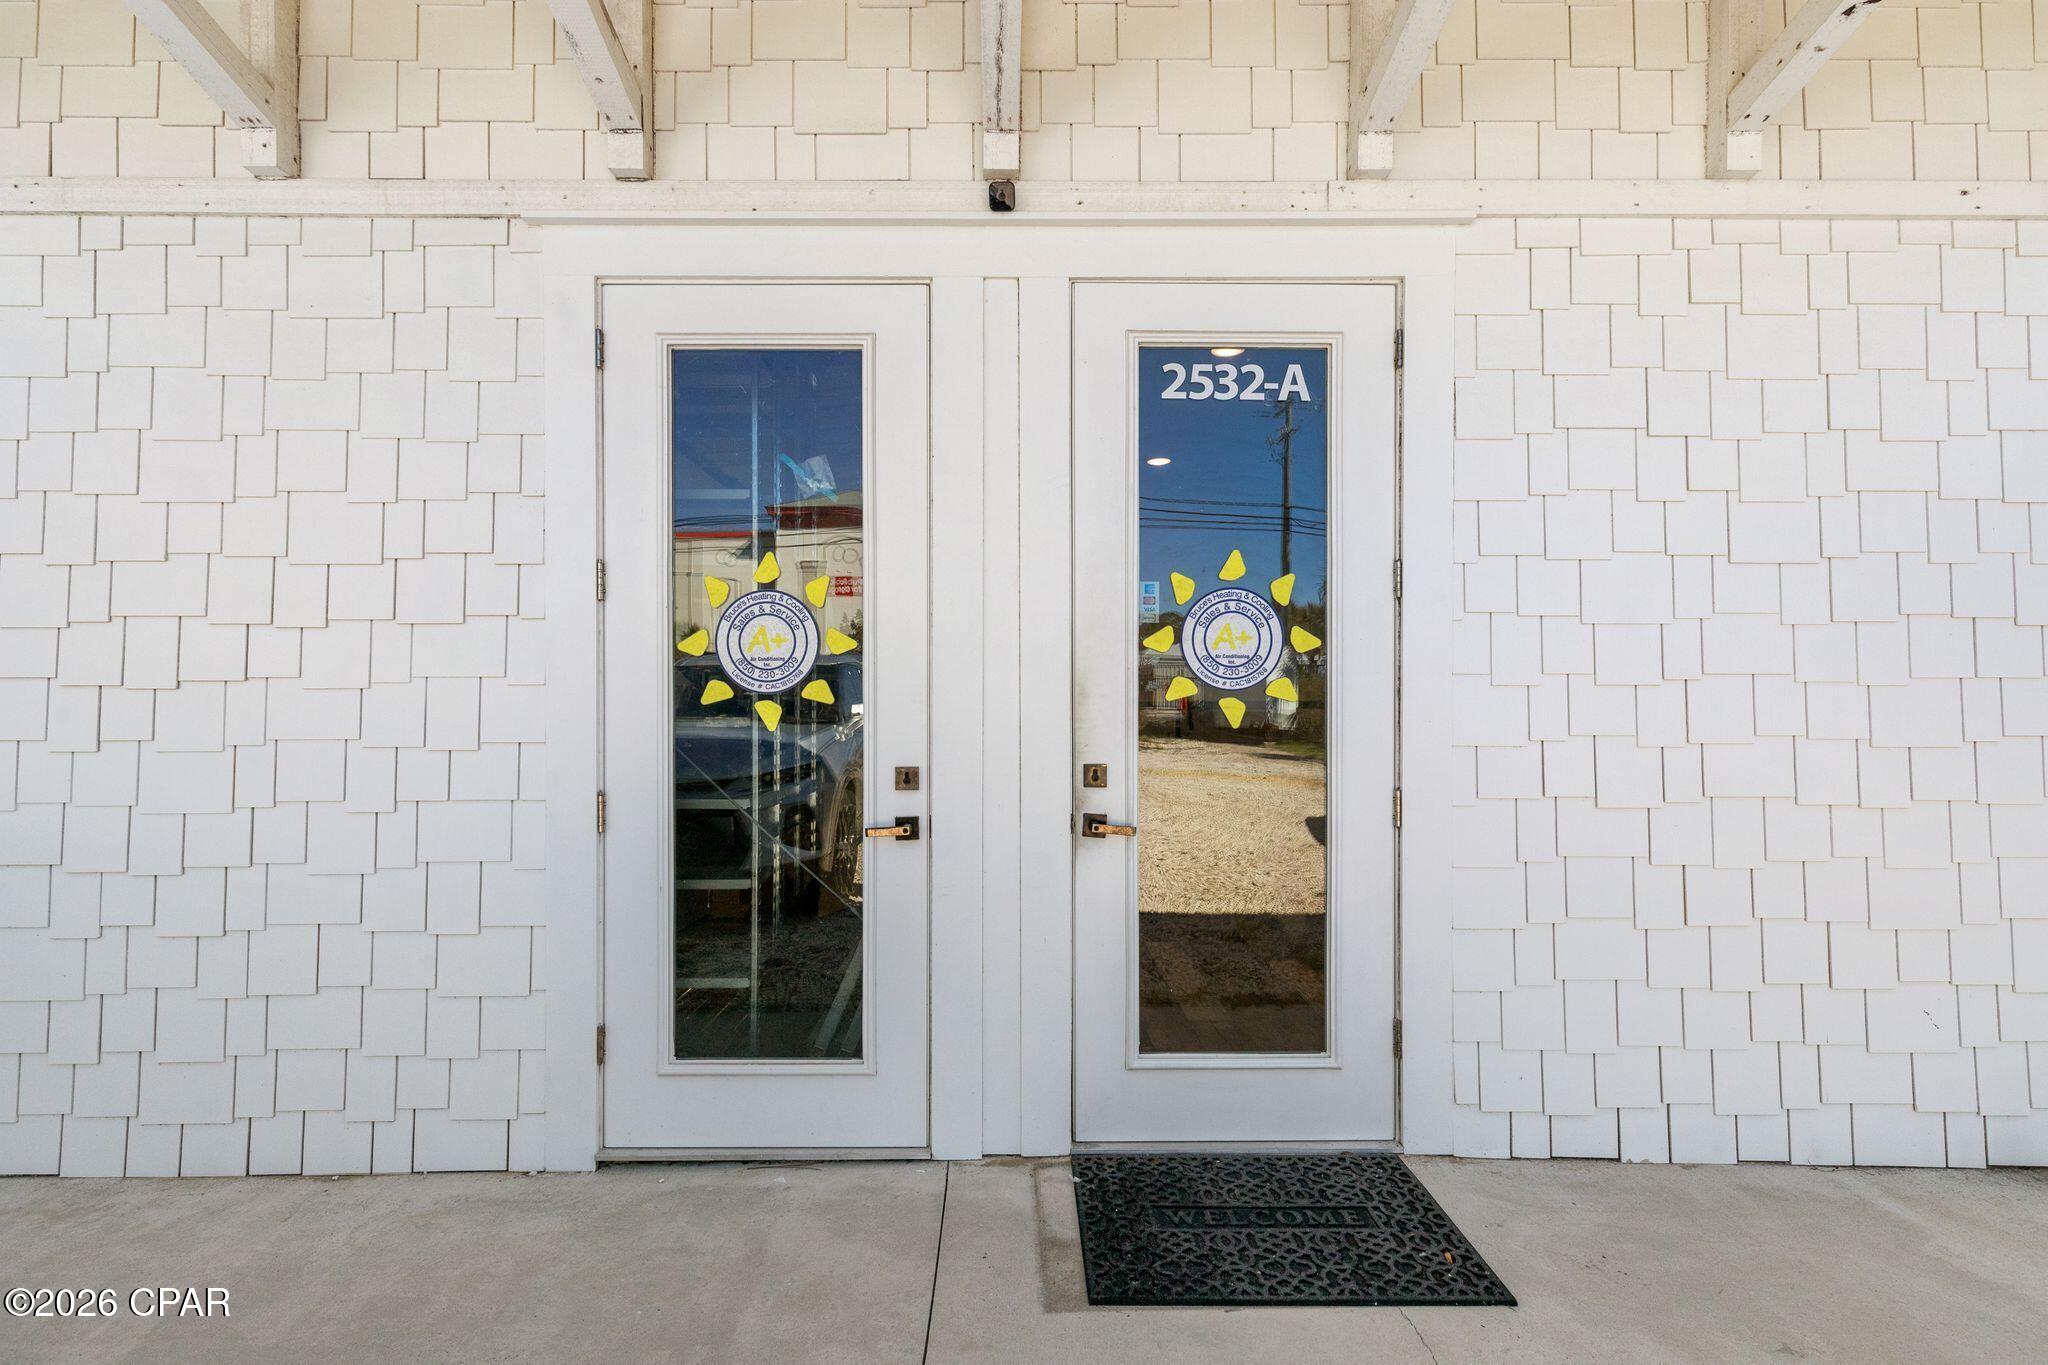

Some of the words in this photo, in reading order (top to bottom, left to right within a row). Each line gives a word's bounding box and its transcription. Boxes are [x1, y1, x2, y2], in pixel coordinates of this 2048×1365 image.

[1161, 363, 1311, 402] 2532-A
[724, 601, 747, 623] Bruce's
[746, 593, 777, 603] Heating
[785, 597, 810, 623] Cooling
[733, 609, 756, 632] Sales
[758, 605, 766, 613] &
[769, 604, 800, 631] Service
[1188, 597, 1213, 620] Bruce's
[1212, 591, 1243, 601] Heating
[1243, 592, 1250, 600] &
[1251, 595, 1275, 621] Cooling
[1198, 606, 1221, 629] Sales
[1223, 603, 1231, 611] &
[1234, 602, 1265, 629] Service
[747, 625, 789, 653] A+
[1212, 622, 1253, 651] A+
[731, 669, 756, 688] License
[735, 657, 756, 677] (850)
[757, 657, 799, 679] 230-3009
[1196, 666, 1220, 685] License
[1229, 666, 1268, 687] CAC1815768
[1200, 654, 1220, 673] (850)
[1222, 654, 1263, 676] 230-3009
[1163, 1209, 1365, 1227] WELCOME
